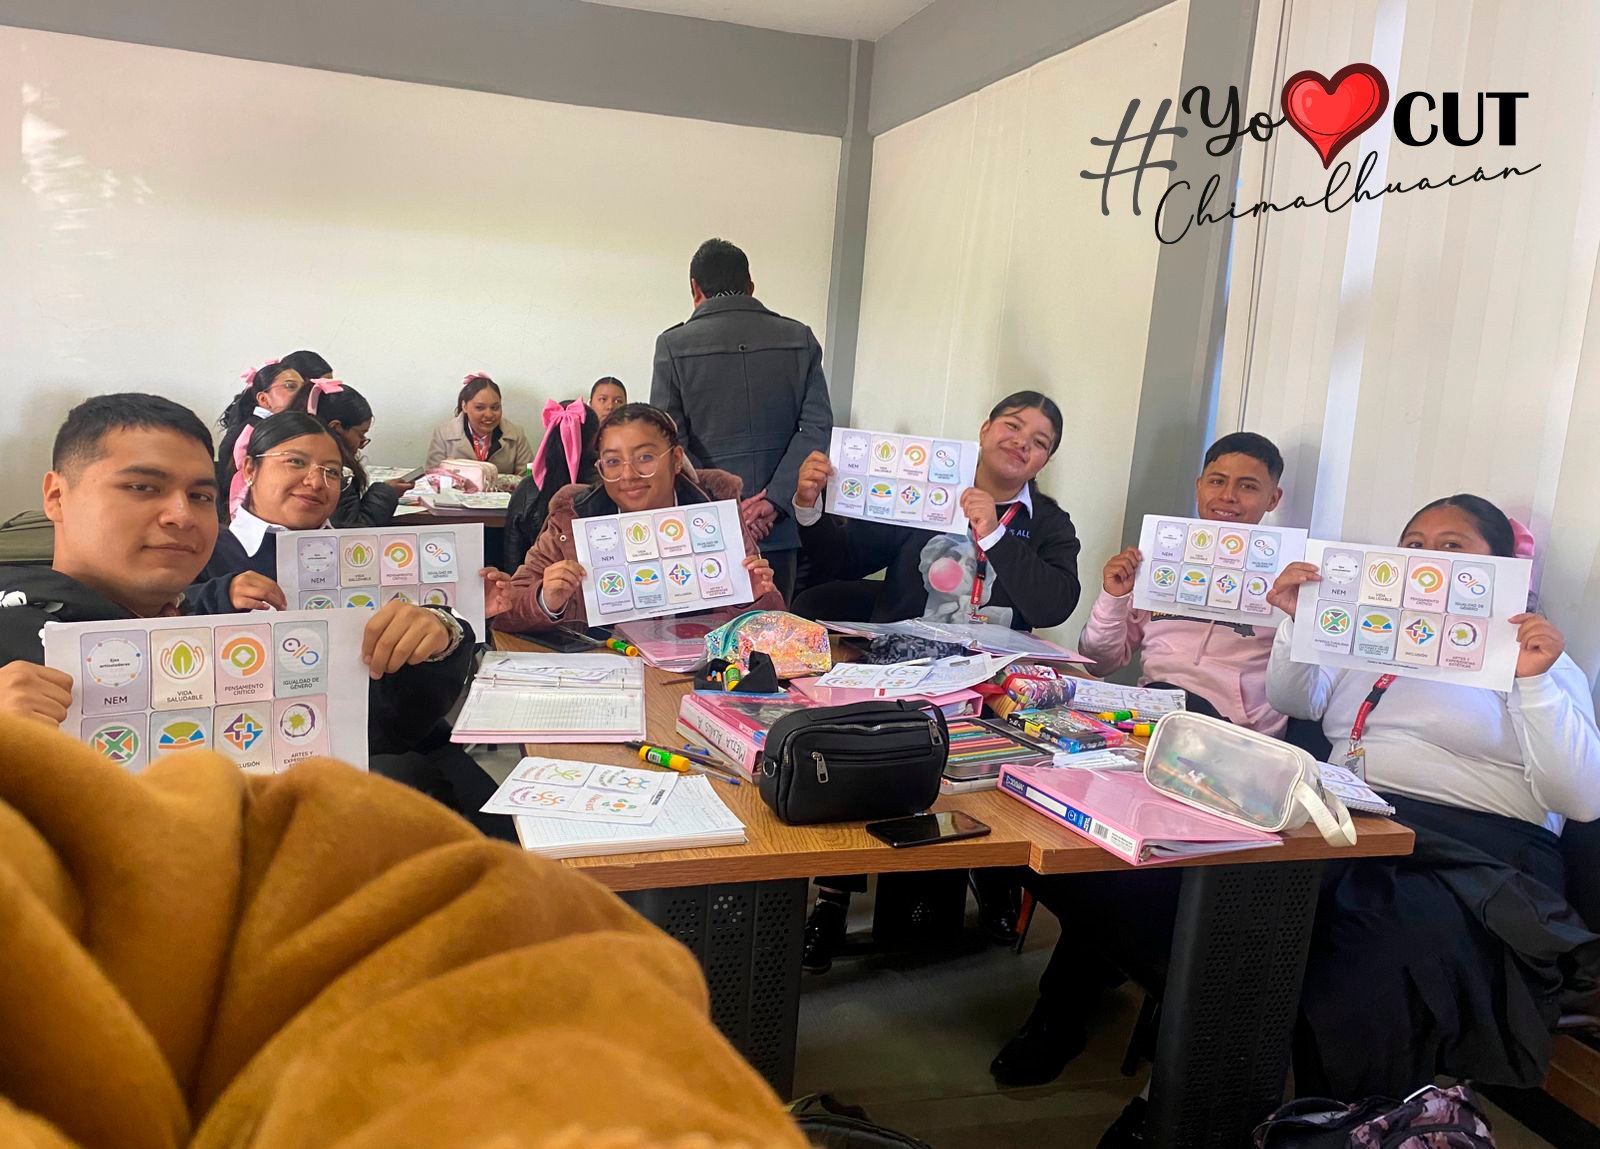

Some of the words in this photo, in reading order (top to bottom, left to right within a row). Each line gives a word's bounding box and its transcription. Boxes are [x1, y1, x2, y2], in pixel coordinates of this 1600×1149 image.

[283, 678, 311, 686] IGUALDAD
[224, 683, 264, 692] PENSAMIENTO
[104, 696, 128, 705] NEM
[167, 695, 204, 703] SALUDABLE
